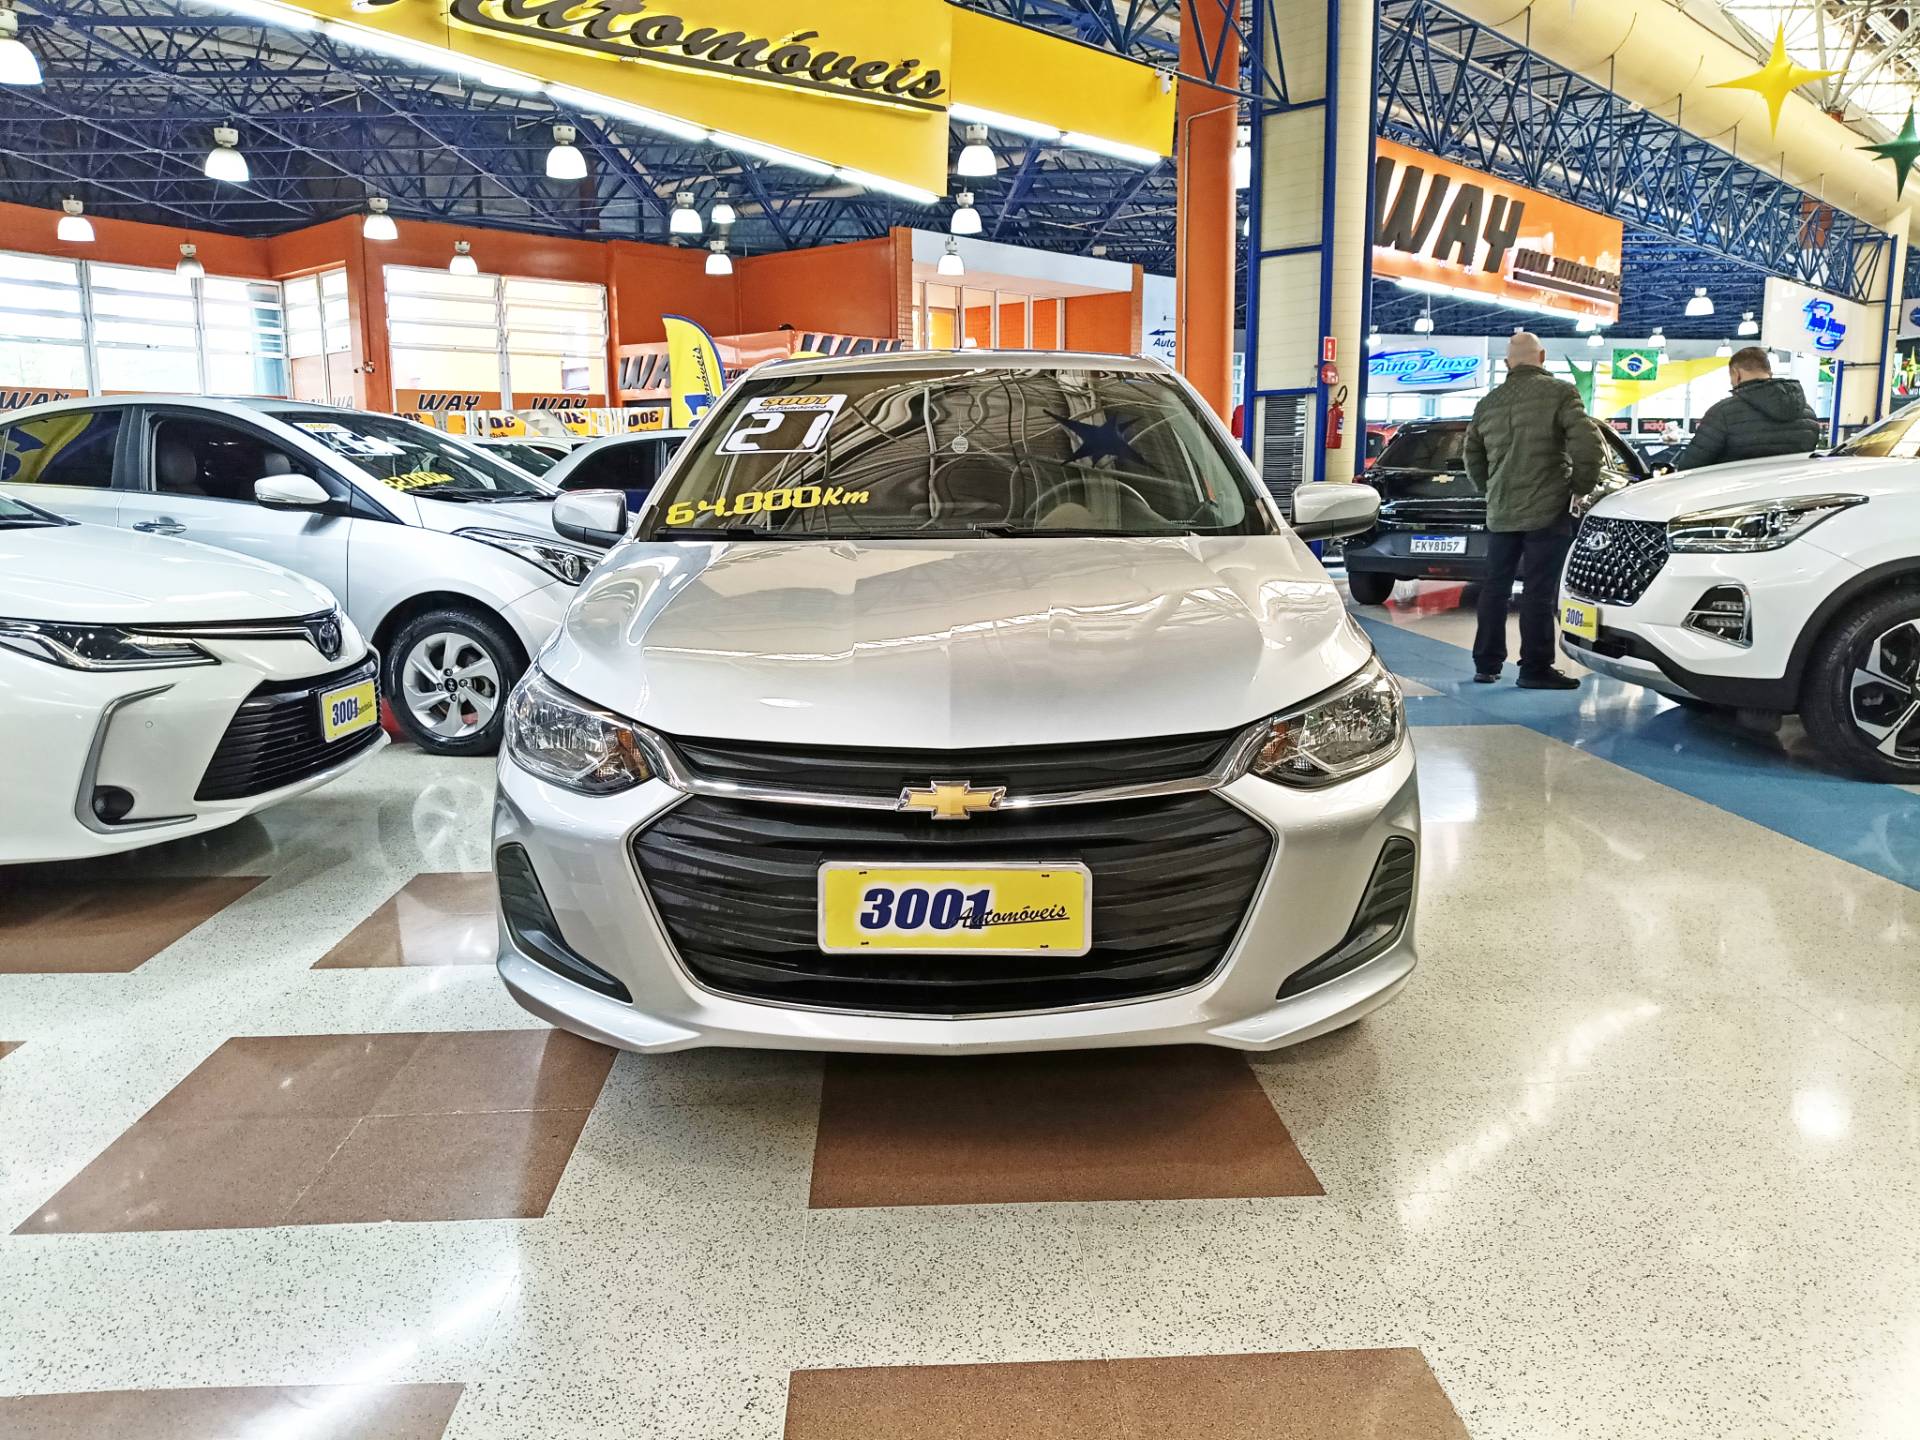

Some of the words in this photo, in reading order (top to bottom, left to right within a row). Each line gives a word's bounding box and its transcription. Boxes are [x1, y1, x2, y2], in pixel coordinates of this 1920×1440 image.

[1374, 156, 1525, 273] WAY
[1153, 338, 1176, 348] Auto
[619, 354, 672, 390] WA
[1370, 359, 1417, 372] Auto
[1421, 358, 1479, 369] Fluxo
[418, 394, 480, 411] WAY
[760, 396, 832, 406] 3001
[725, 412, 830, 450] 21
[665, 486, 870, 525] 64.000Km
[1414, 541, 1460, 552] FKY8D57
[1566, 607, 1584, 627] 3001
[332, 697, 358, 726] 3001
[860, 888, 990, 931] 3001
[953, 904, 1069, 929] Automóveis
